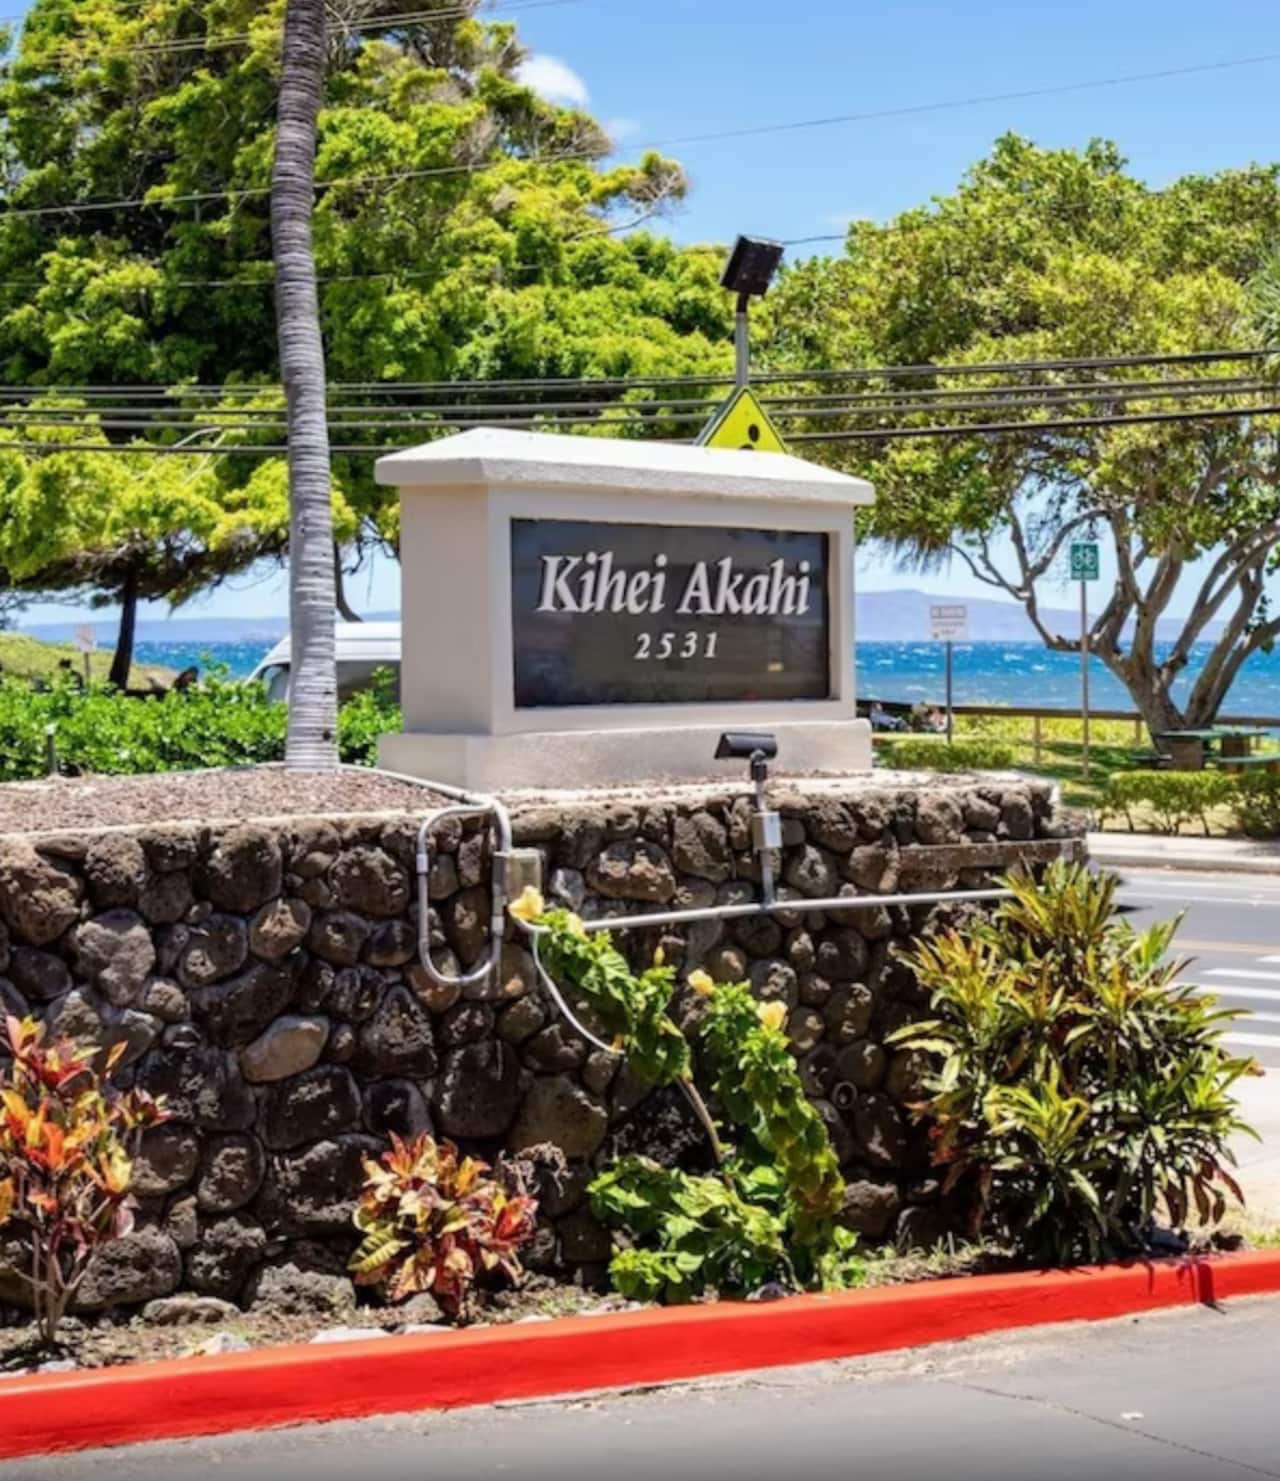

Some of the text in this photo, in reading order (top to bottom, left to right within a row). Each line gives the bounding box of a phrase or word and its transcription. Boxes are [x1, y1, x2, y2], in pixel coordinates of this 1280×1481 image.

[536, 552, 811, 616] Kihei Akahi
[634, 631, 719, 660] 2531
